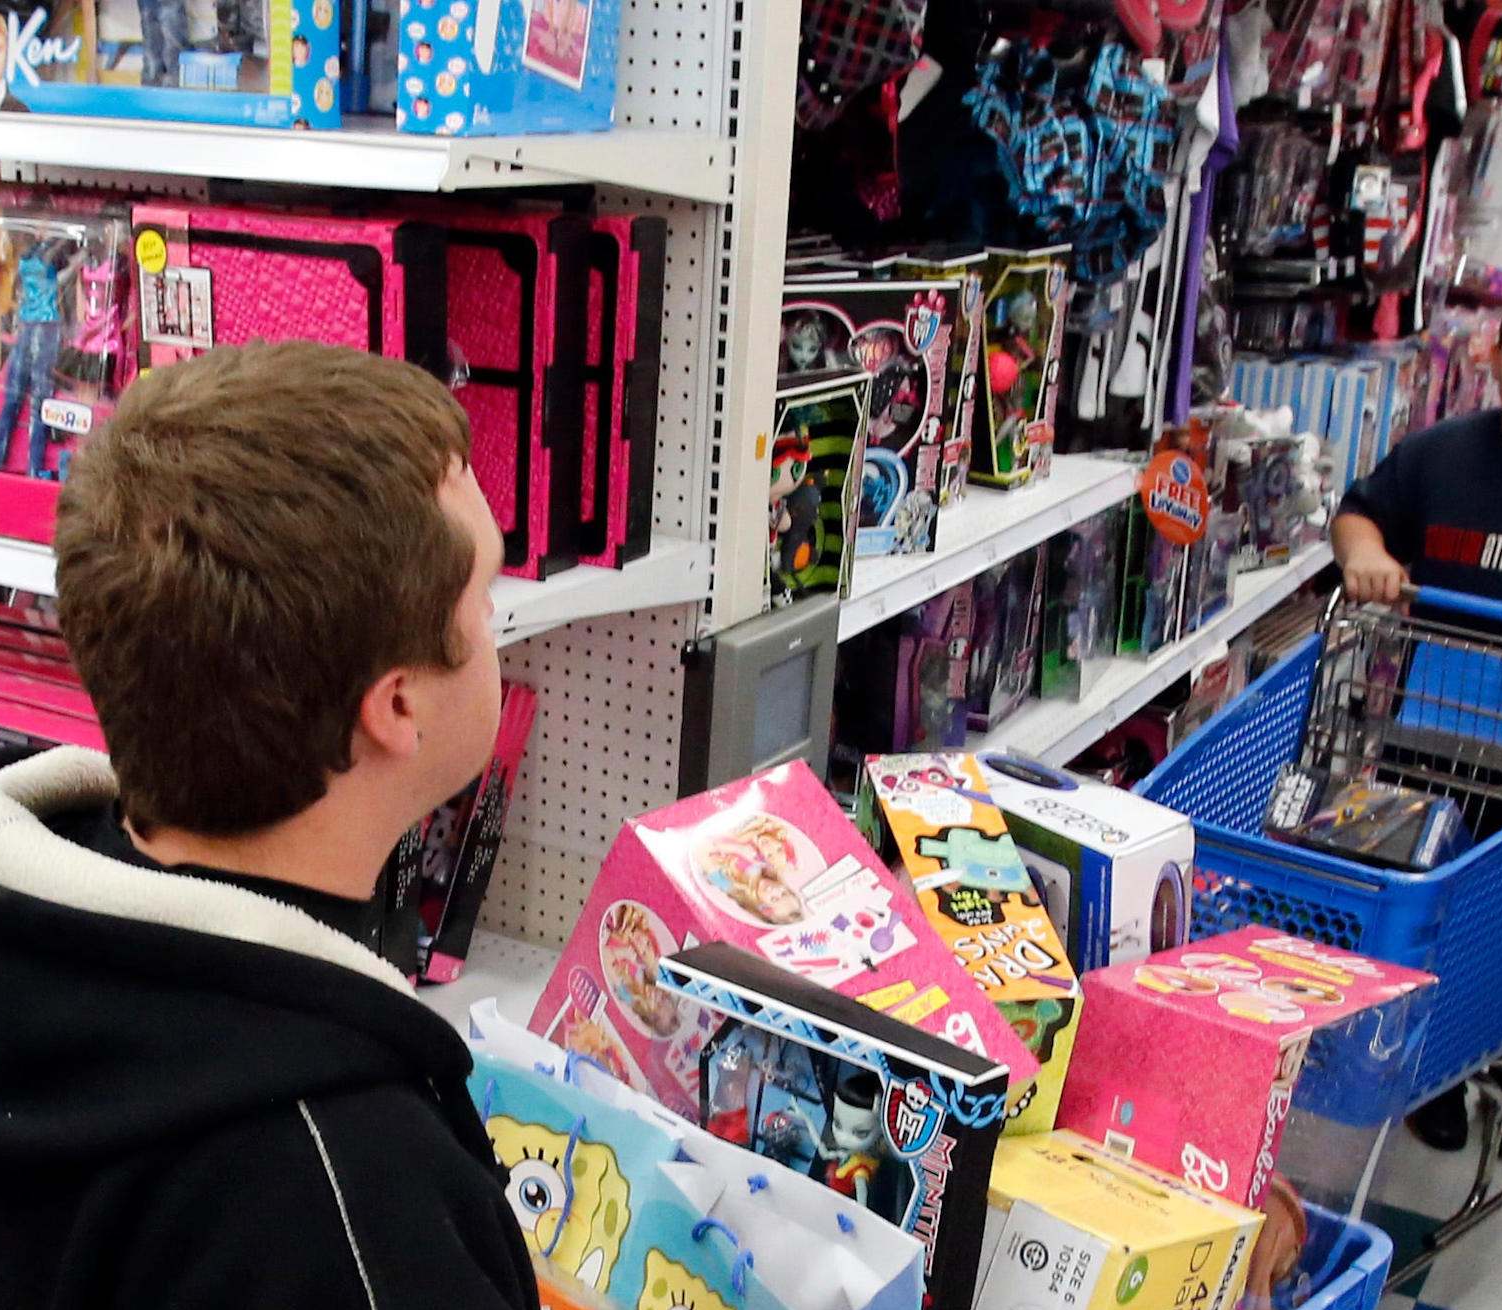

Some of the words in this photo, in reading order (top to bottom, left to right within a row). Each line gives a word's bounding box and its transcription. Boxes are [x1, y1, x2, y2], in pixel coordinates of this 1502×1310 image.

[6, 7, 82, 88] Ken
[1157, 473, 1201, 509] FREE
[1248, 1085, 1293, 1208] Barbie
[1048, 1243, 1070, 1296] 10364
[1070, 1251, 1091, 1291] SIZE
[1064, 1292, 1076, 1305] 6
